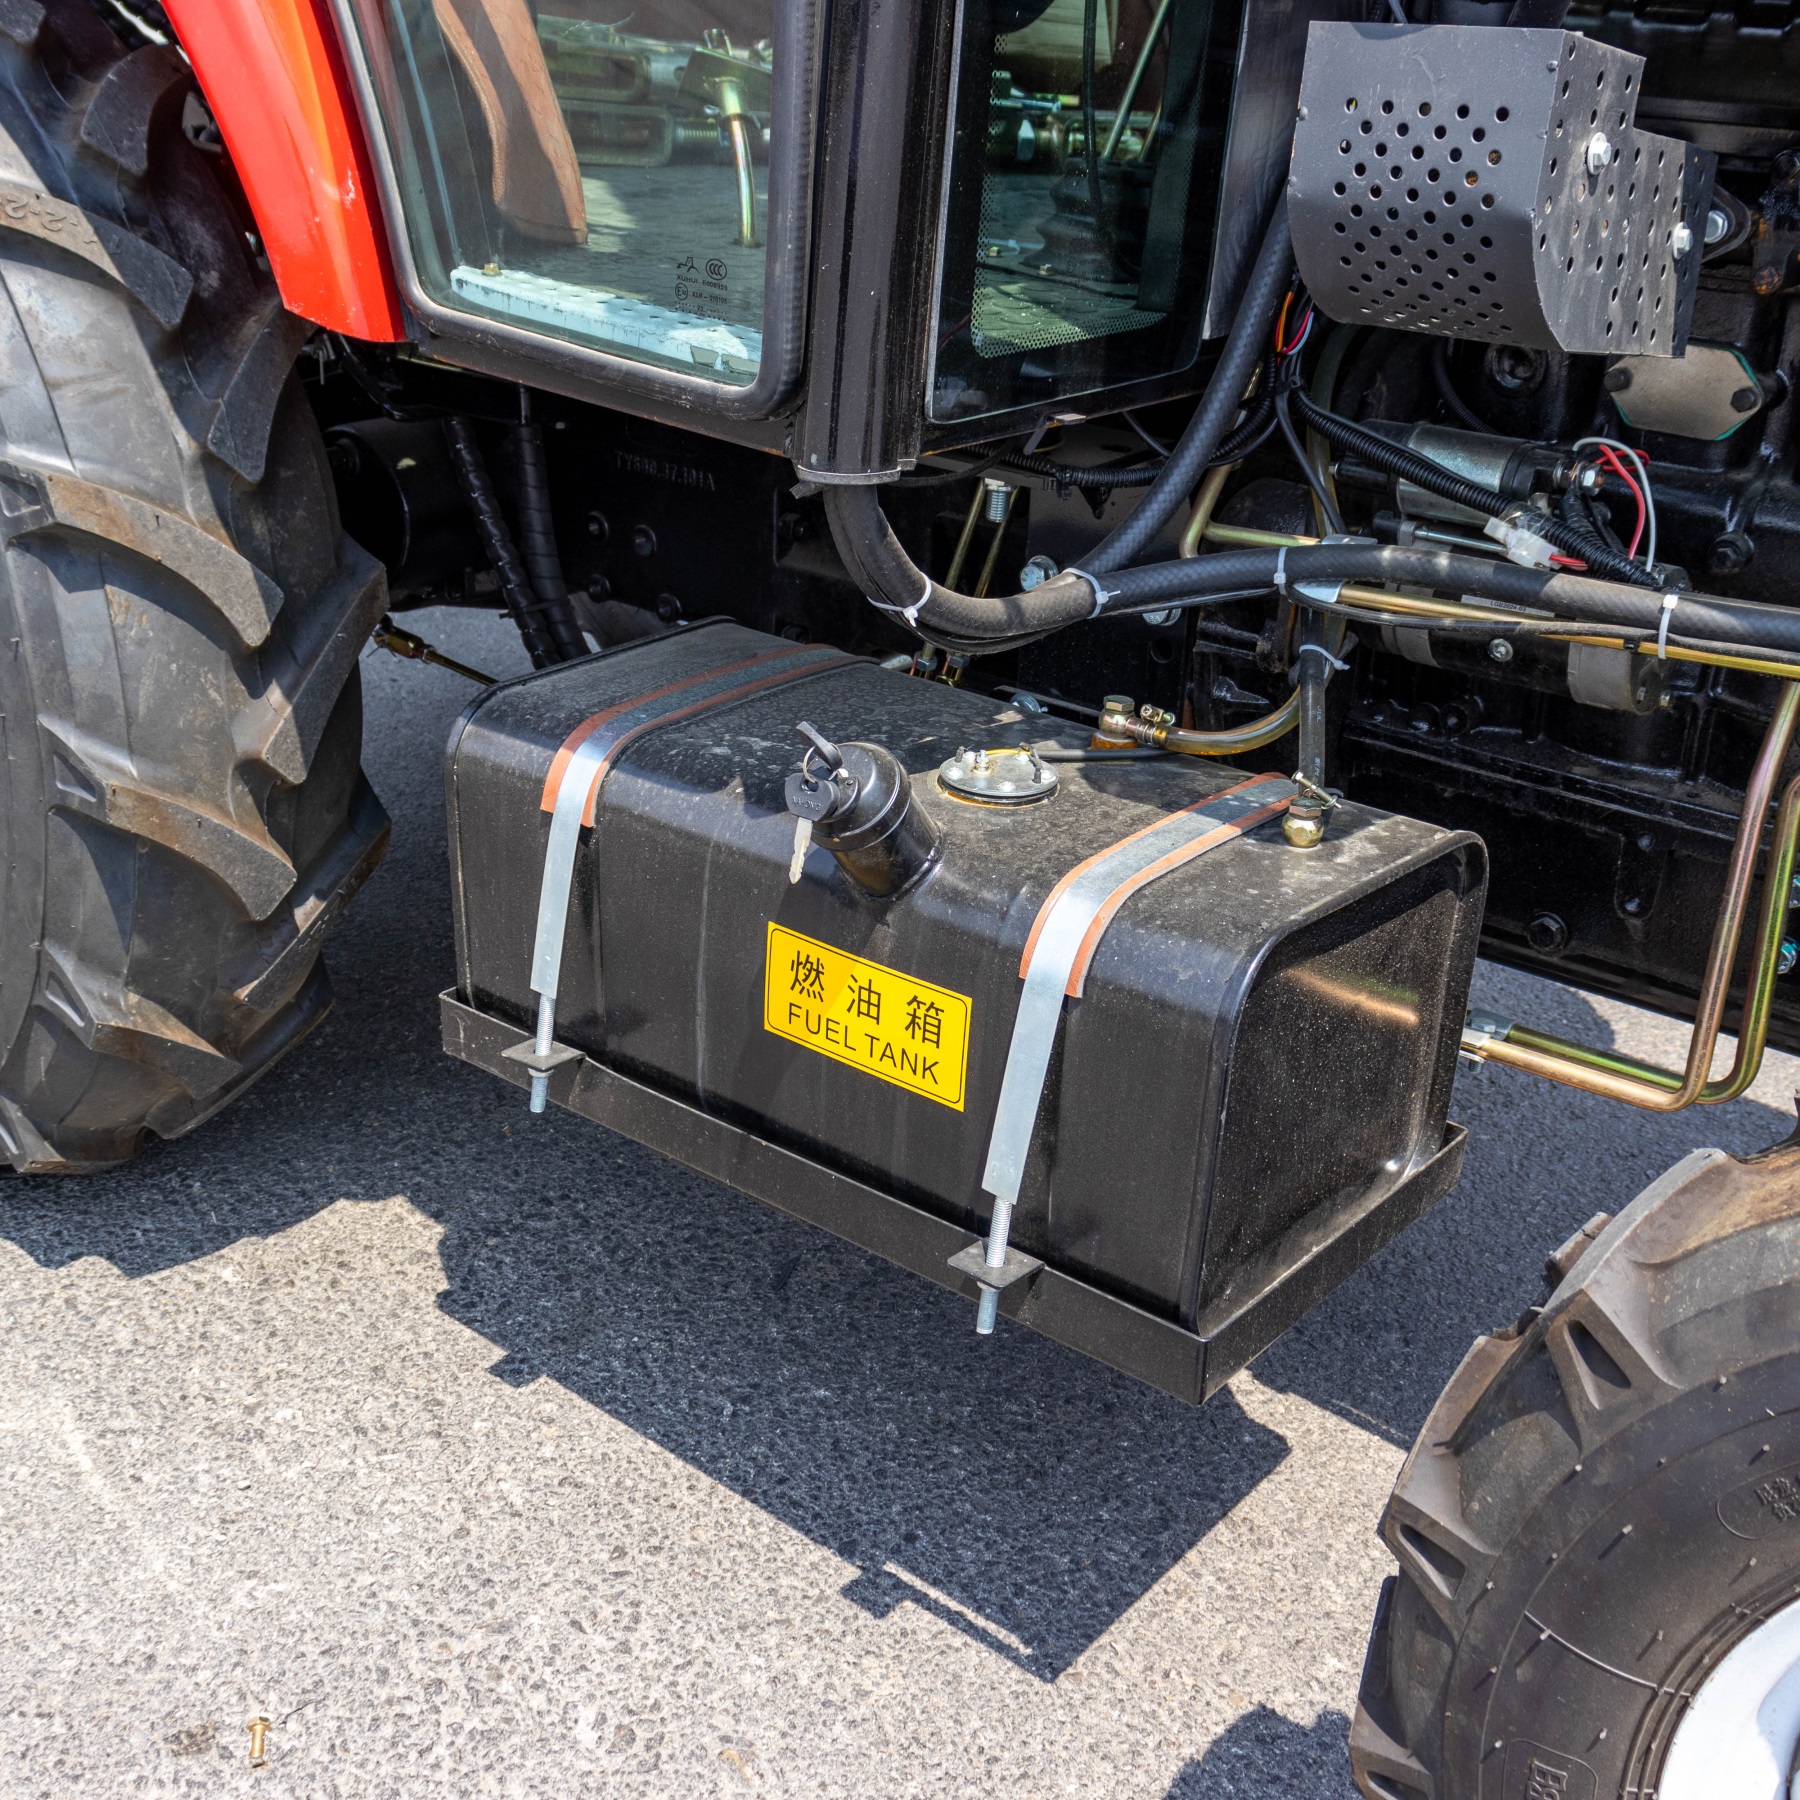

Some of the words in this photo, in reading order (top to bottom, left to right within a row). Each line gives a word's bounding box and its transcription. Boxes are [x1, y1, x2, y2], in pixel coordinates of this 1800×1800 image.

[677, 274, 699, 283] XUHUI
[790, 950, 945, 1049] 燃油箱
[788, 1002, 857, 1052] FUEL
[864, 1032, 940, 1085] TANK
